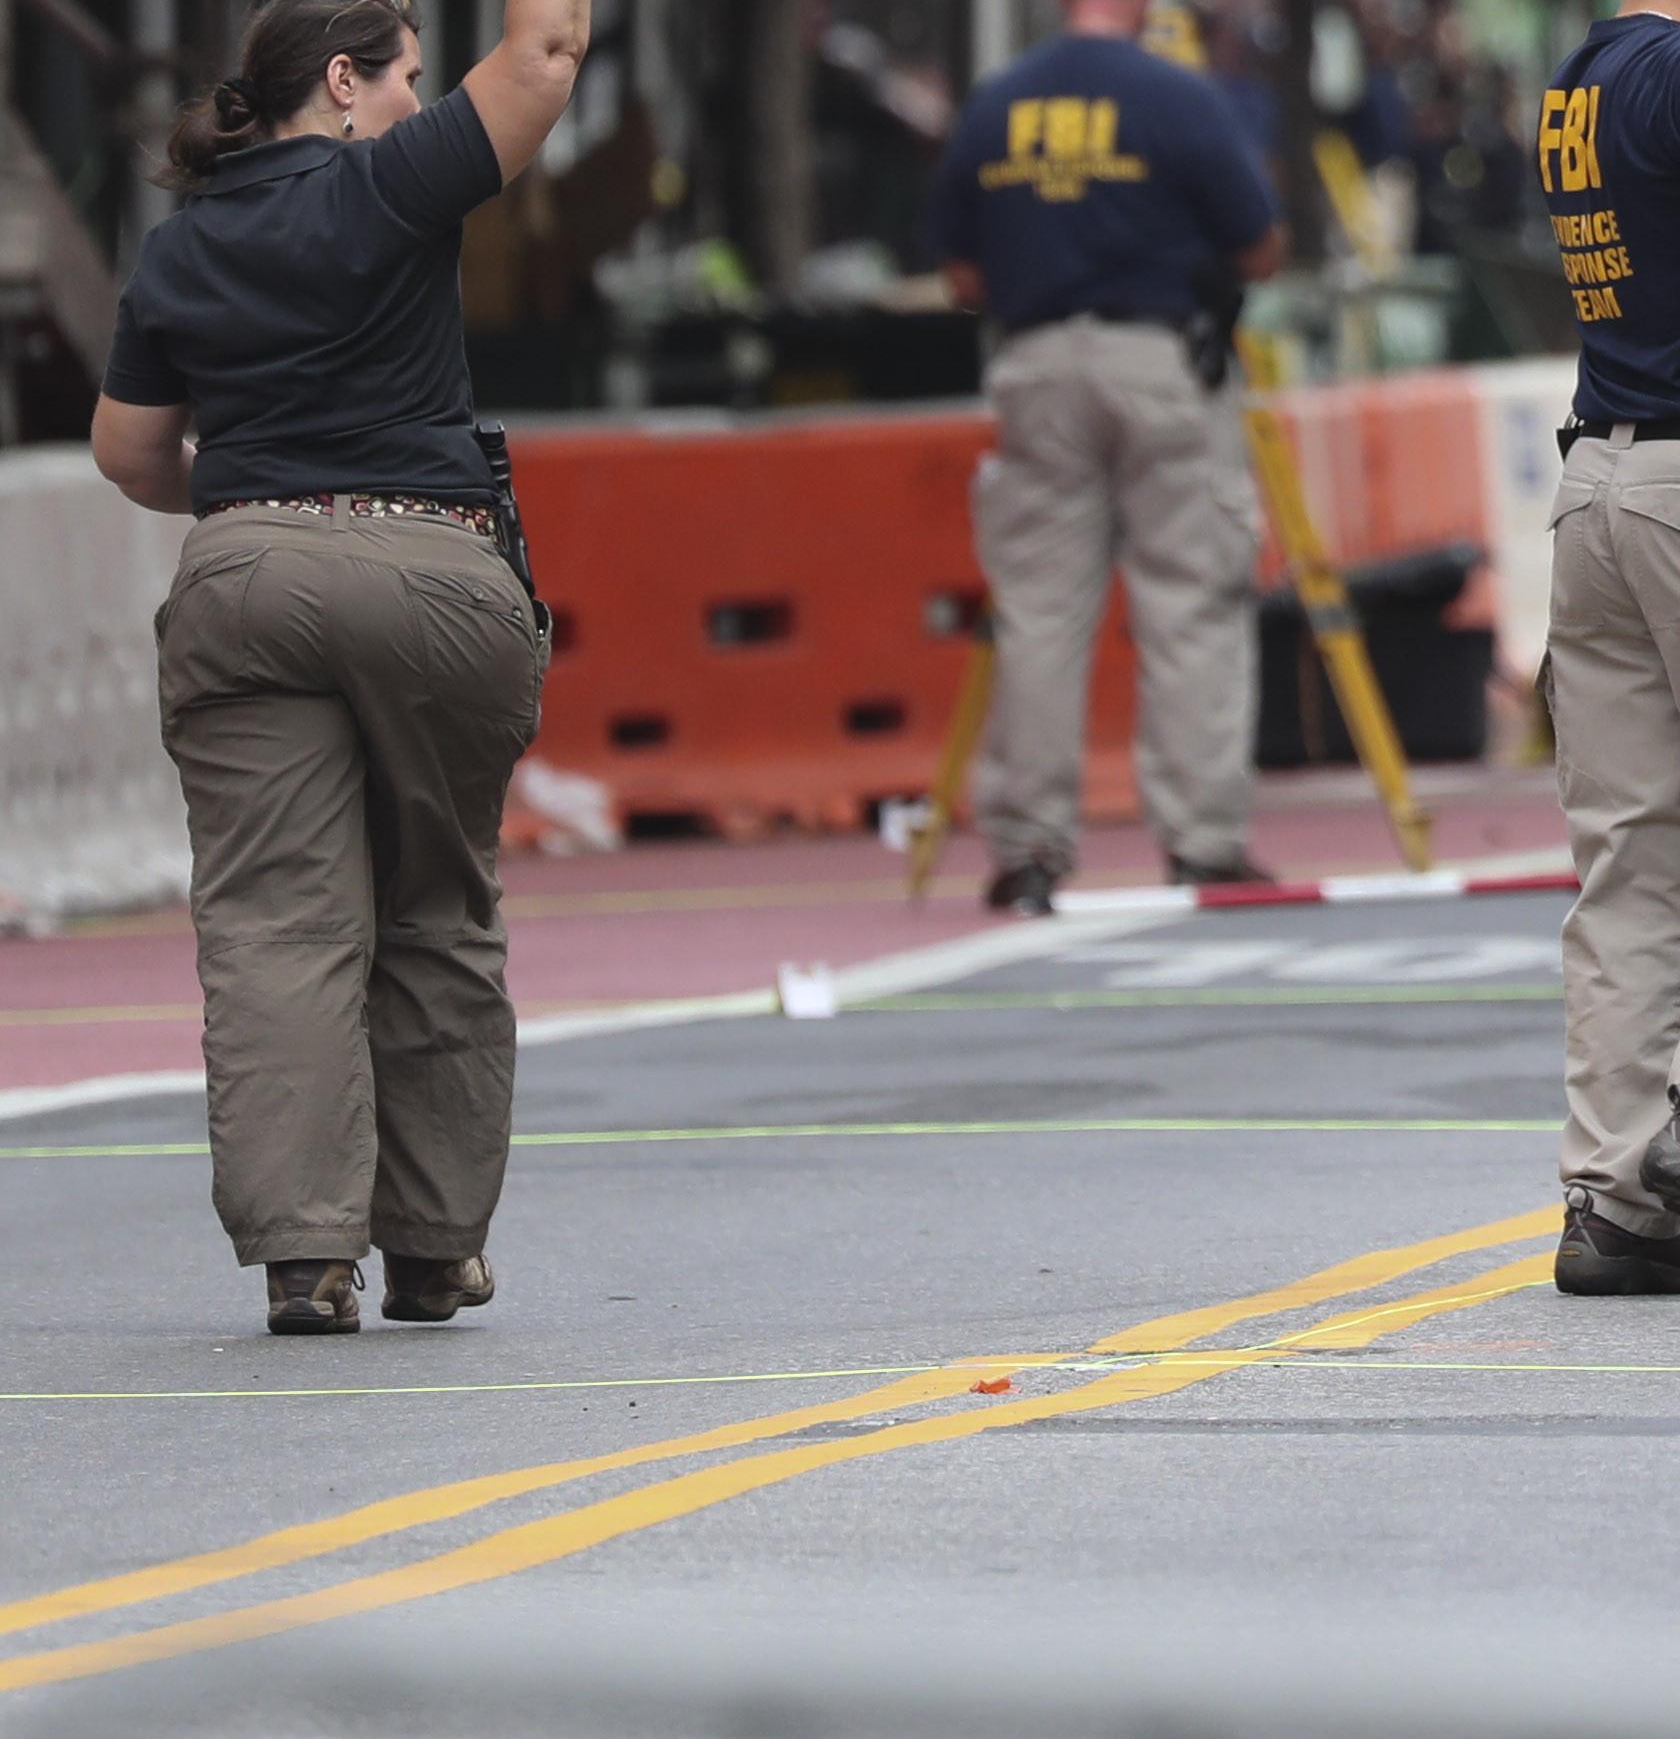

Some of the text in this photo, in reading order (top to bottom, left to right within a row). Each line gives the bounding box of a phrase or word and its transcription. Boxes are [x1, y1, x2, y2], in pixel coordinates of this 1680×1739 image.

[1539, 85, 1602, 193] FBI
[1561, 246, 1634, 286] SPONSE
[1571, 286, 1623, 322] TEAM
